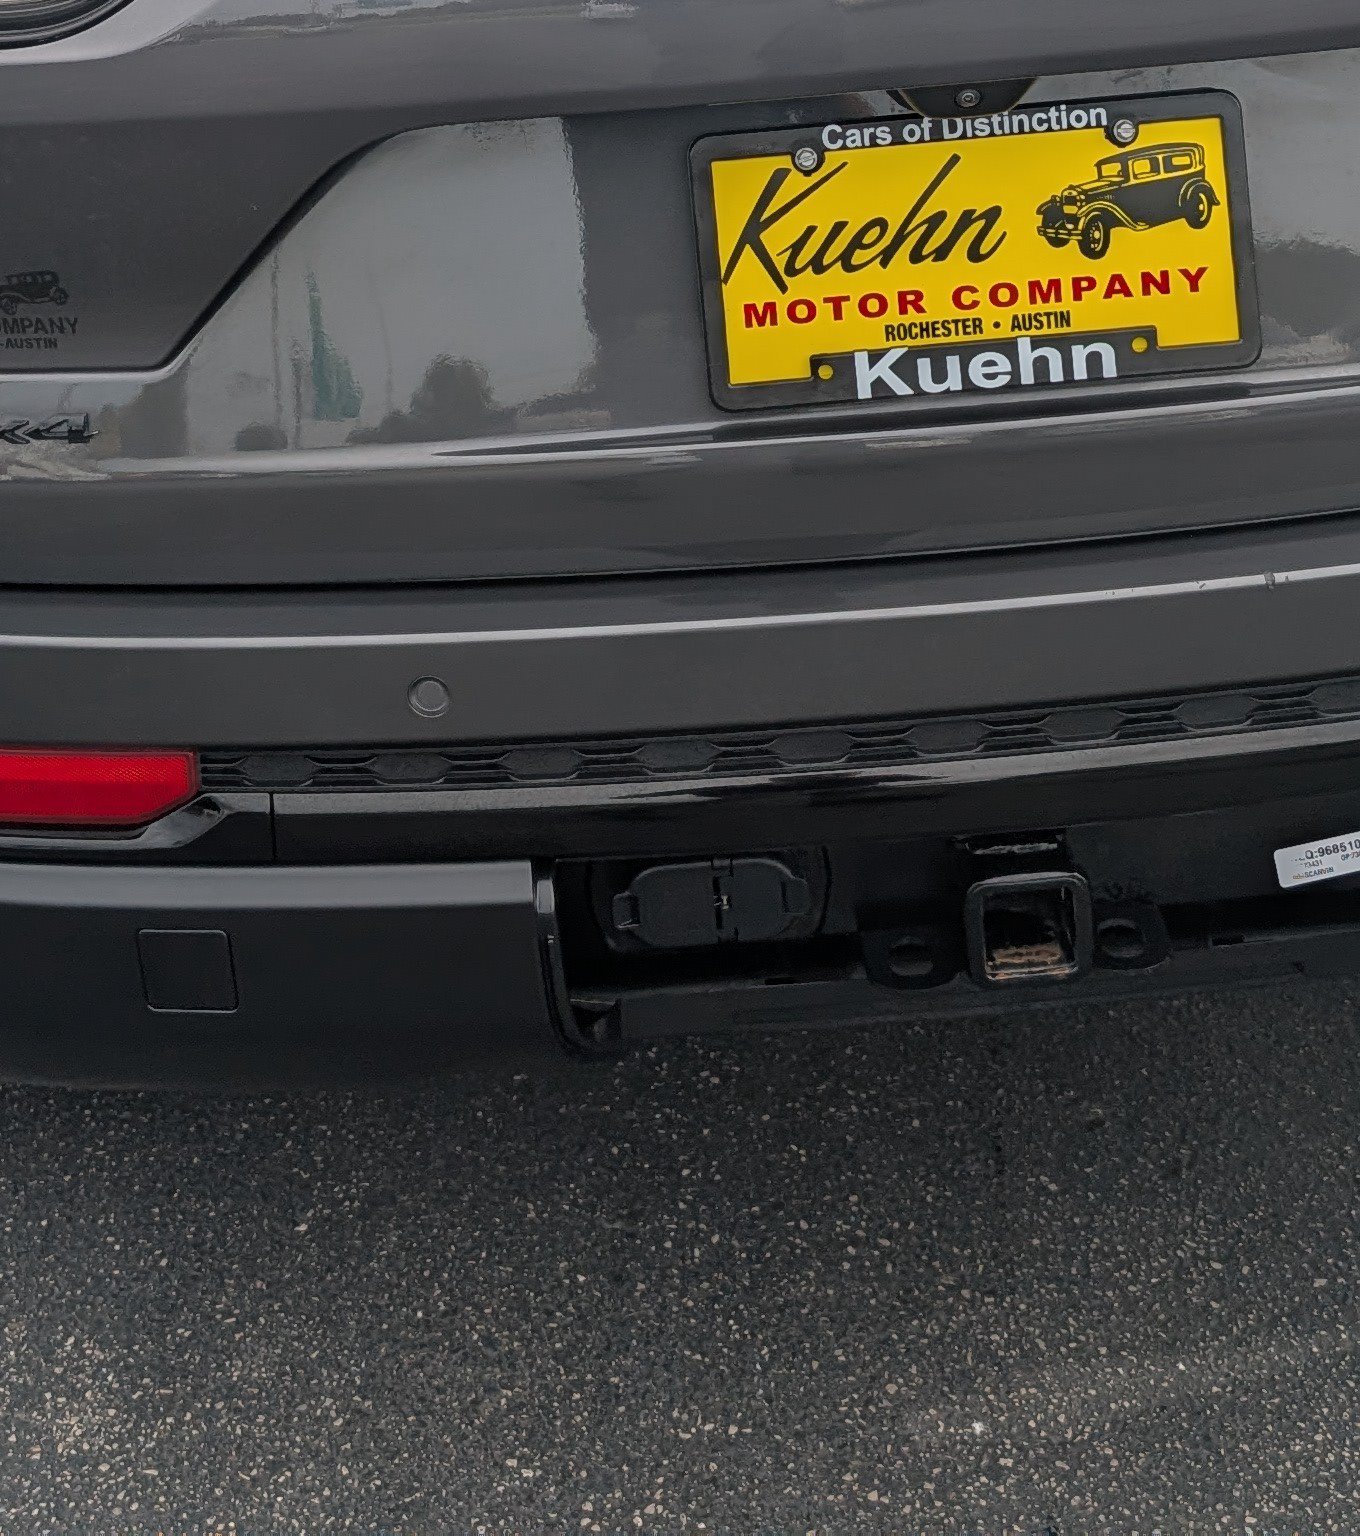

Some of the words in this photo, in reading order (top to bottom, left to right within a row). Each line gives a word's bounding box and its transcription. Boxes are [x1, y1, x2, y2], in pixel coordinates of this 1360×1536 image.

[821, 124, 893, 150] Cars
[902, 117, 933, 142] of
[943, 104, 1108, 140] Distinction
[721, 153, 1008, 294] Kuehn
[743, 289, 927, 329] MOTOR
[952, 266, 1210, 312] COMPANY
[884, 317, 984, 342] ROCHESTER
[1010, 310, 1071, 332] AUSTIN
[854, 336, 1118, 400] Kuehn
